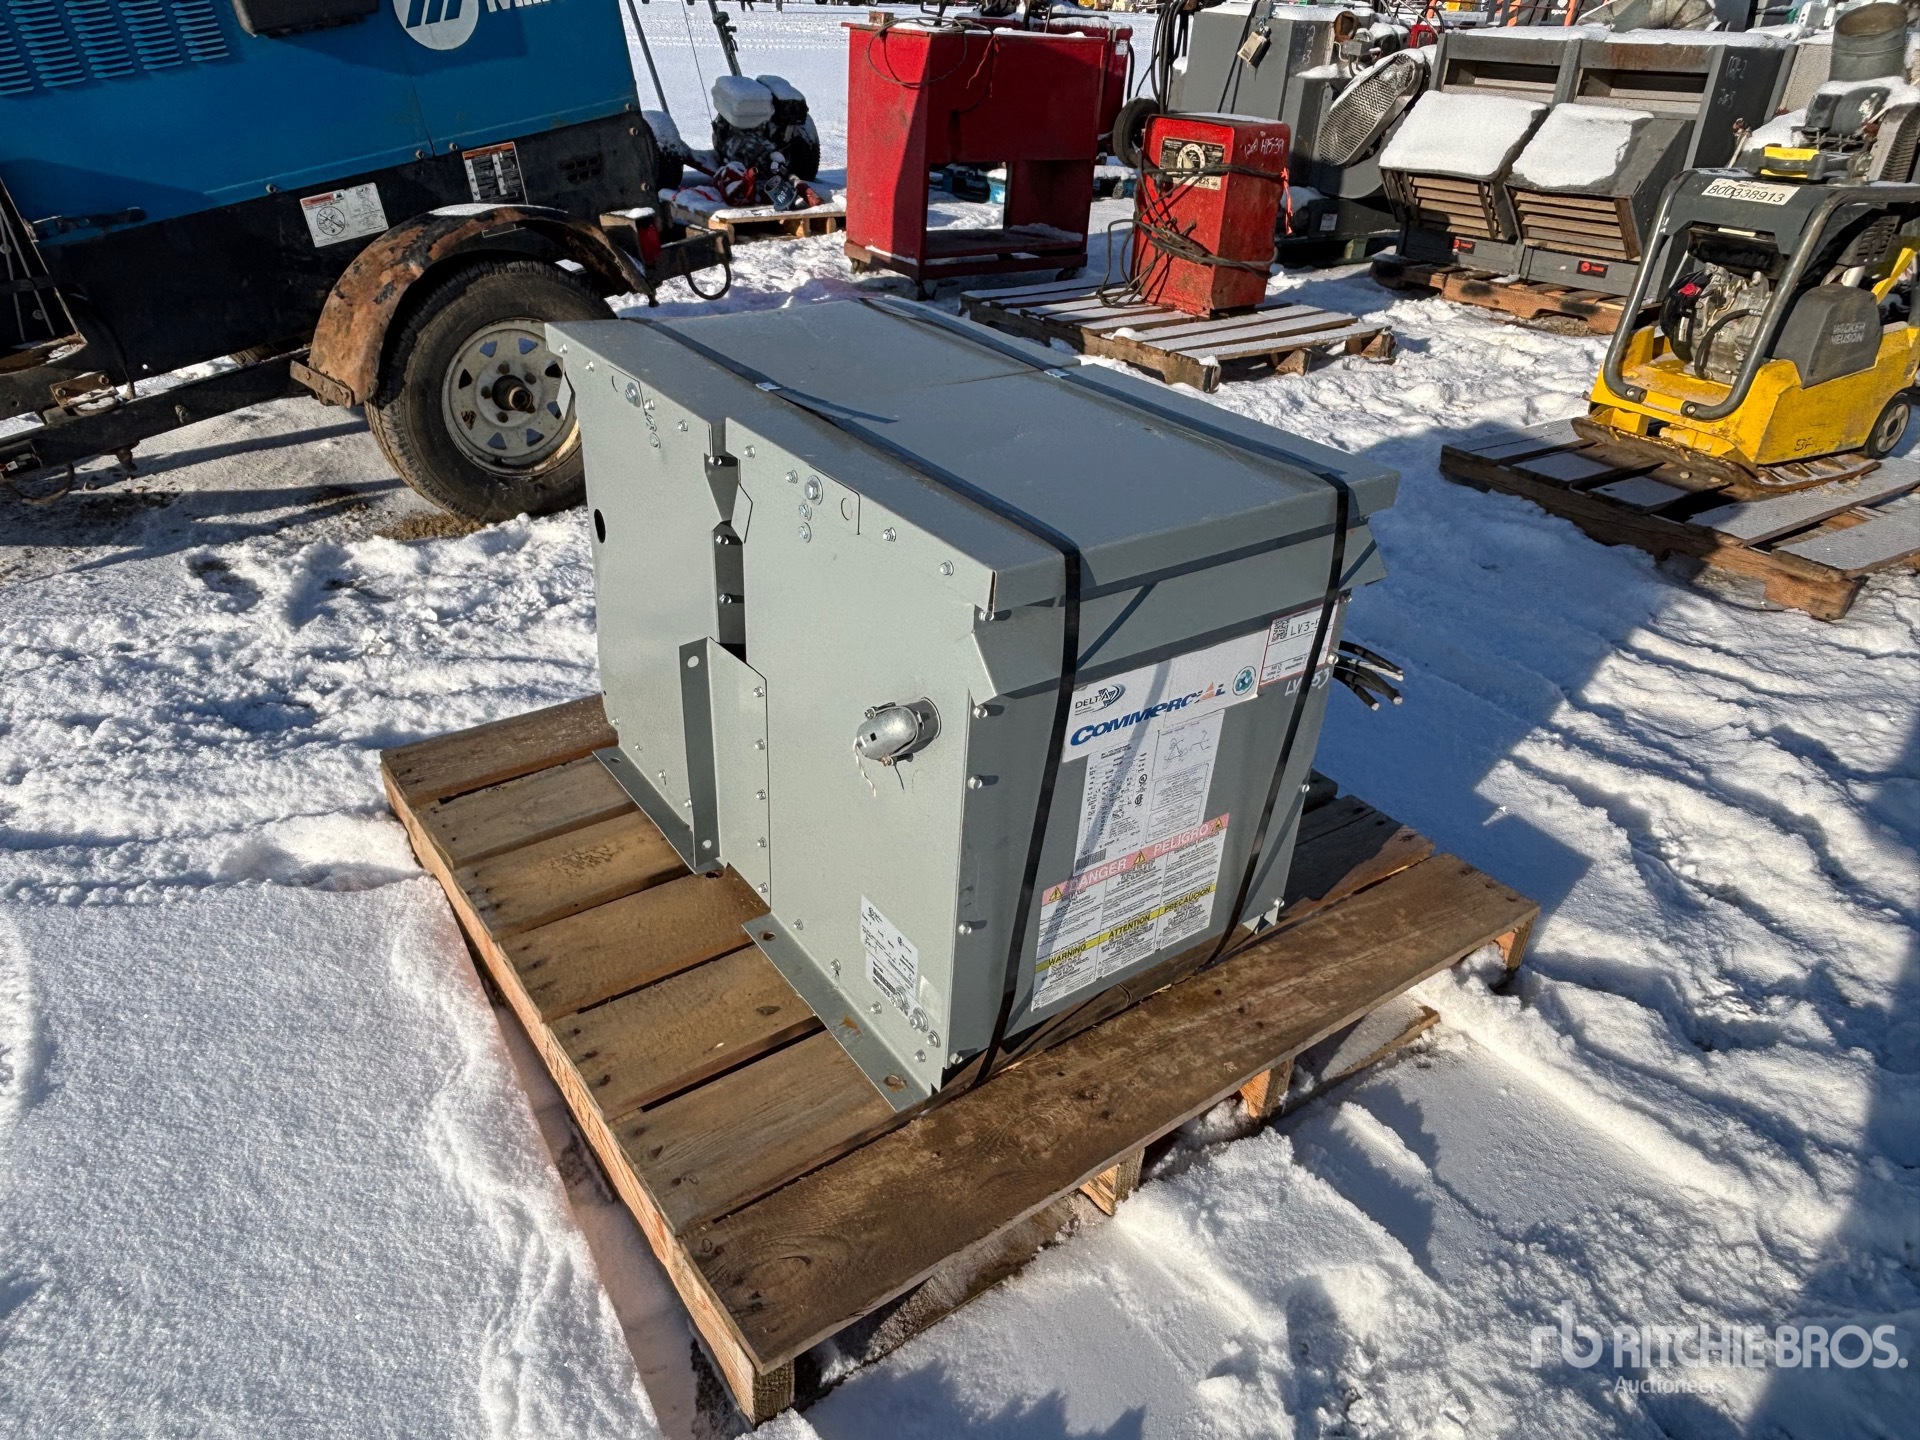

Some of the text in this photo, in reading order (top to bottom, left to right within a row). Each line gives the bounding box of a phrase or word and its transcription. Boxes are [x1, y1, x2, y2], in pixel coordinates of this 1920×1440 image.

[1153, 823, 1210, 857] PELIGRO
[1068, 858, 1127, 893] DANGER
[1108, 912, 1151, 938] ATTENTION
[1048, 943, 1087, 967] WARNING
